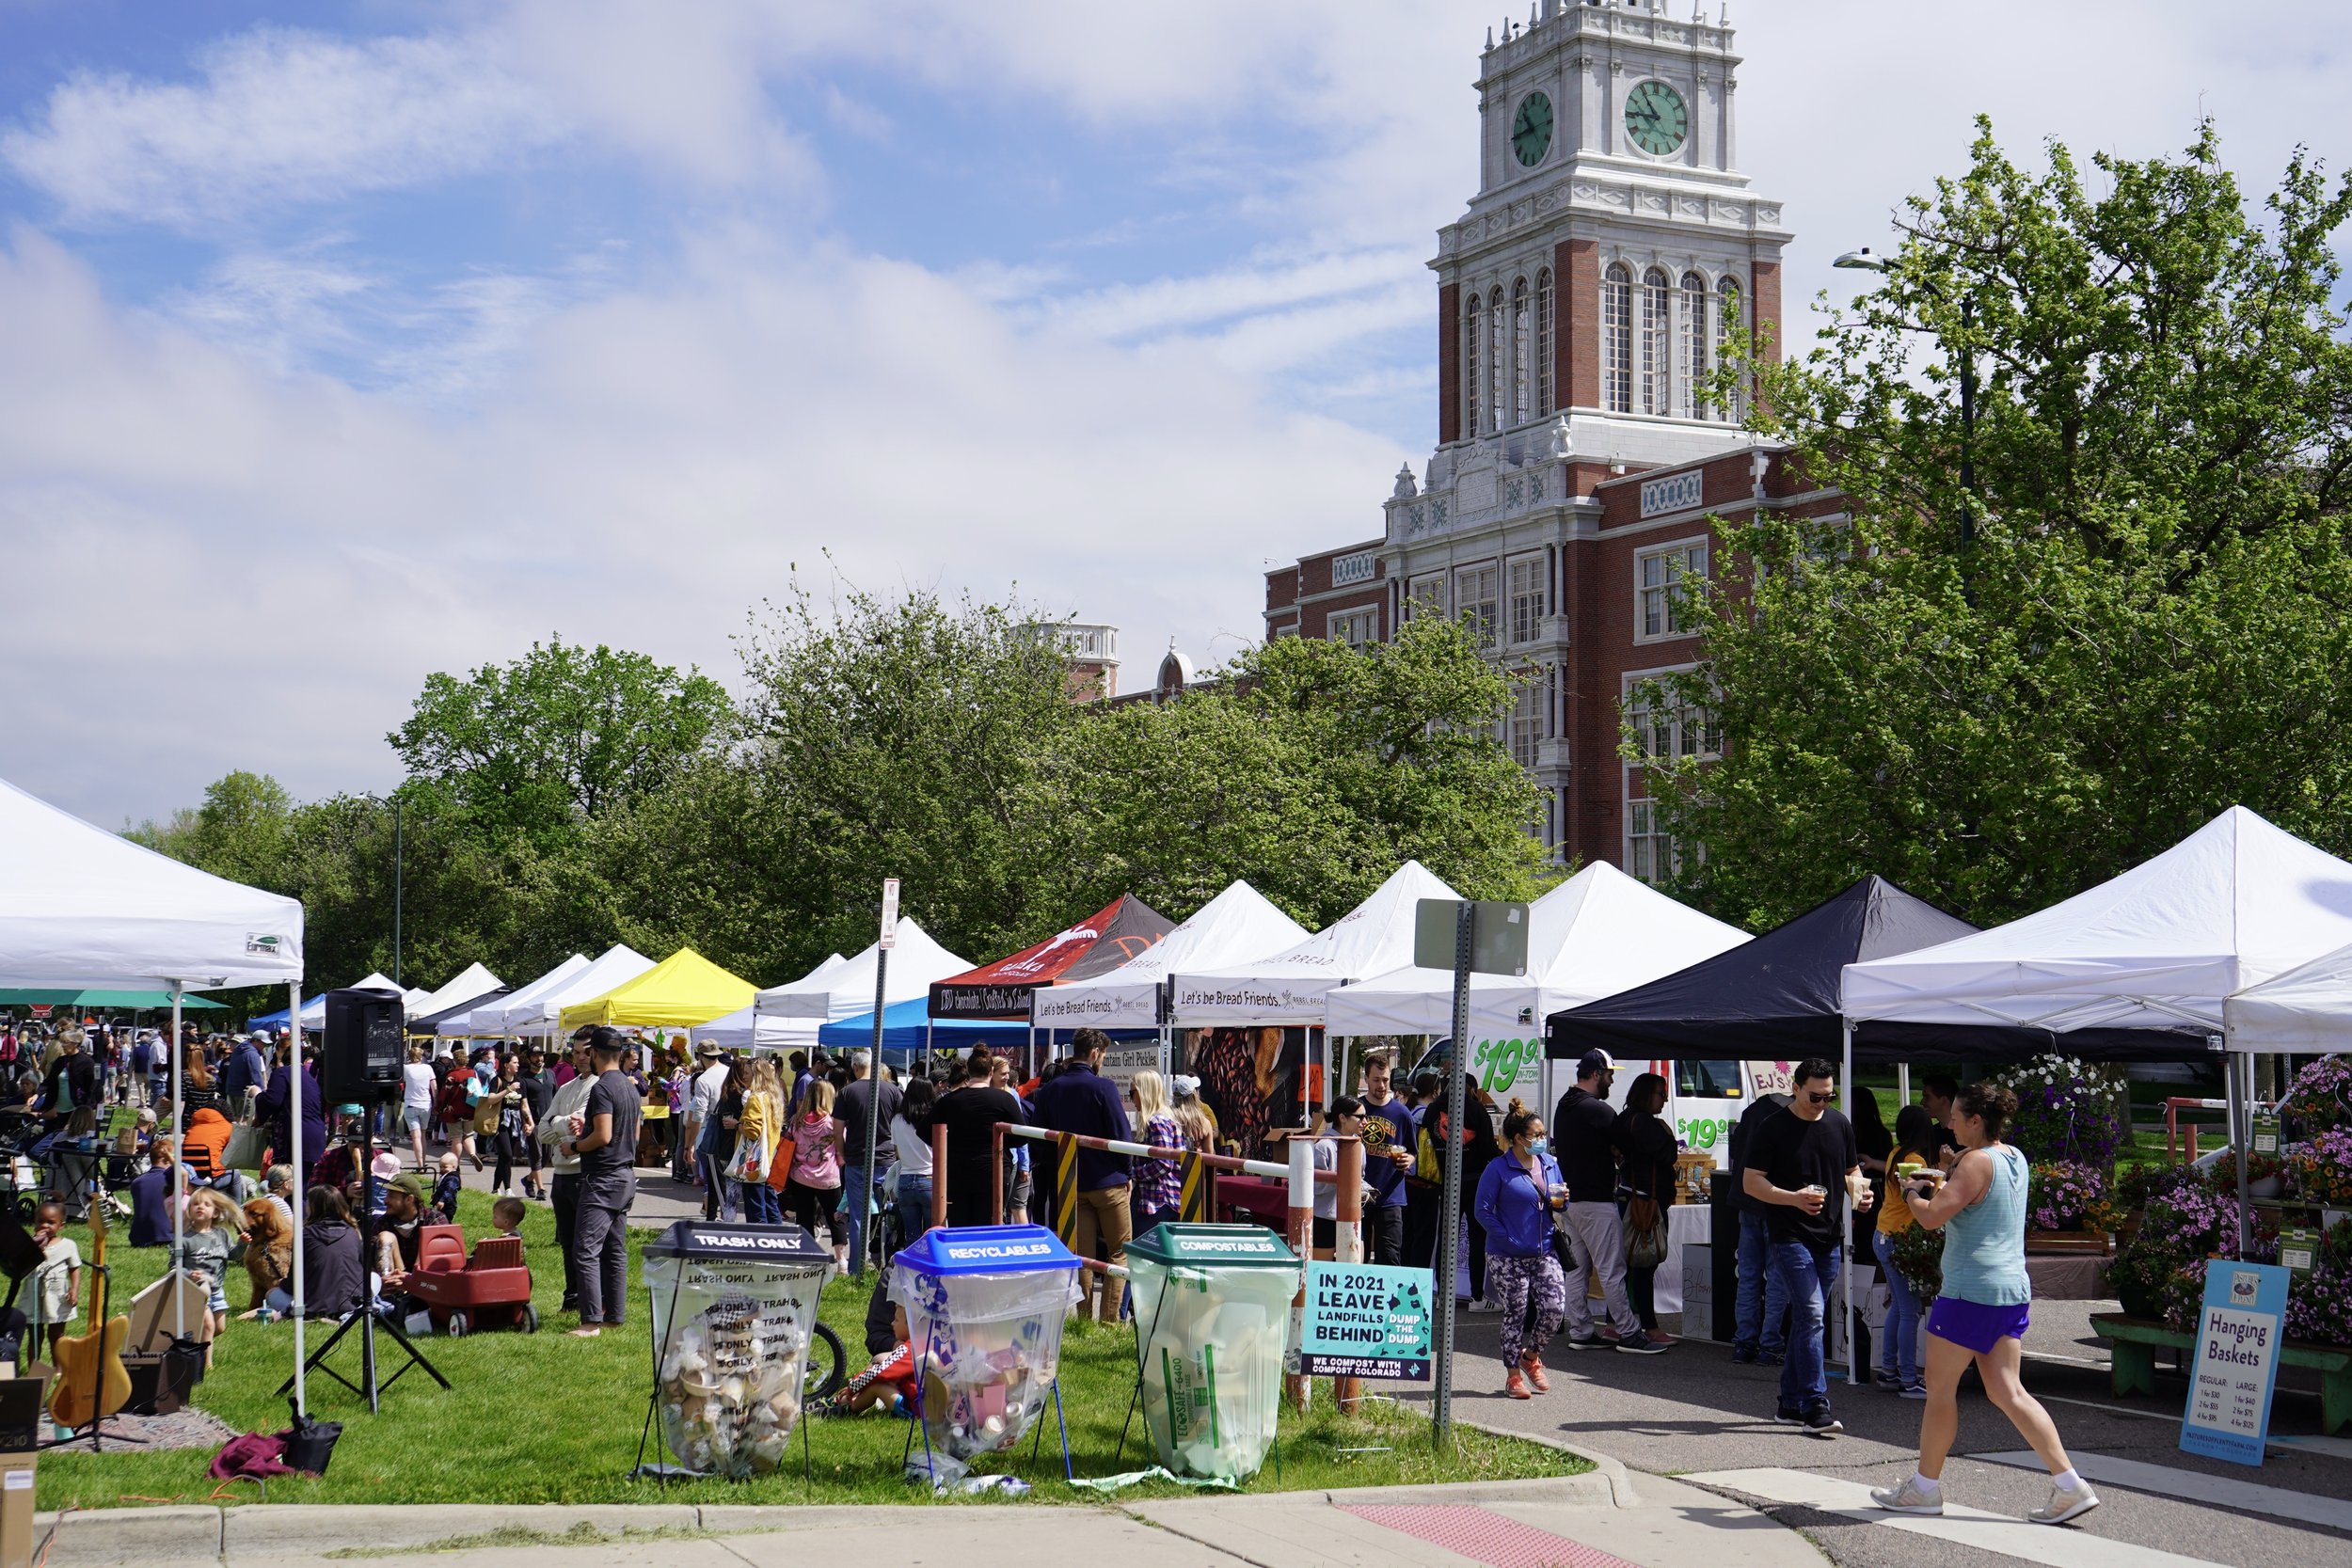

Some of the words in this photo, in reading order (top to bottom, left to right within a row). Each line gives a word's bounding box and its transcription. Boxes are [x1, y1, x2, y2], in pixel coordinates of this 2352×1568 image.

[1181, 990, 1201, 1005] Let's
[1203, 990, 1215, 1005] be
[1216, 990, 1242, 1006] Bread
[1245, 990, 1281, 1007] Friends.
[1041, 1003, 1056, 1016] Let's
[1057, 1000, 1065, 1016] be
[1066, 999, 1085, 1015] Bread
[1087, 998, 1113, 1014] Friends.
[1122, 1052, 1135, 1068] Girl
[1136, 1050, 1157, 1068] Pickles
[694, 1235, 756, 1248] TRASH
[757, 1238, 802, 1250] ONLY
[1180, 1241, 1277, 1253] COMPOSTABLES
[948, 1243, 1052, 1259] RECYCLABLES
[1319, 1274, 1337, 1288] IN
[1344, 1275, 1385, 1291] 2021
[724, 1302, 753, 1312] ONLY
[1318, 1291, 1385, 1310] LEAVE
[1317, 1311, 1384, 1324] LANDFILLS
[1389, 1313, 1421, 1325] DUMP
[725, 1320, 753, 1330] ONLY
[1395, 1324, 1414, 1333] THE
[2210, 1313, 2267, 1347] Hanging
[1315, 1325, 1384, 1343] BEHIND
[1389, 1334, 1420, 1345] DUMP
[725, 1338, 753, 1350] ONLY
[2208, 1340, 2260, 1367] Baskets
[726, 1357, 753, 1369] ONLY
[1312, 1356, 1327, 1366] WE
[1329, 1357, 1375, 1369] COMPOST
[1377, 1360, 1401, 1370] WITH
[1312, 1365, 1352, 1374] COMPOST
[1355, 1367, 1401, 1377] COLORADO
[2199, 1374, 2229, 1387] REGULAR:
[2235, 1380, 2259, 1393] LARGE:
[2245, 1397, 2256, 1405] $40
[2244, 1408, 2253, 1417] $75
